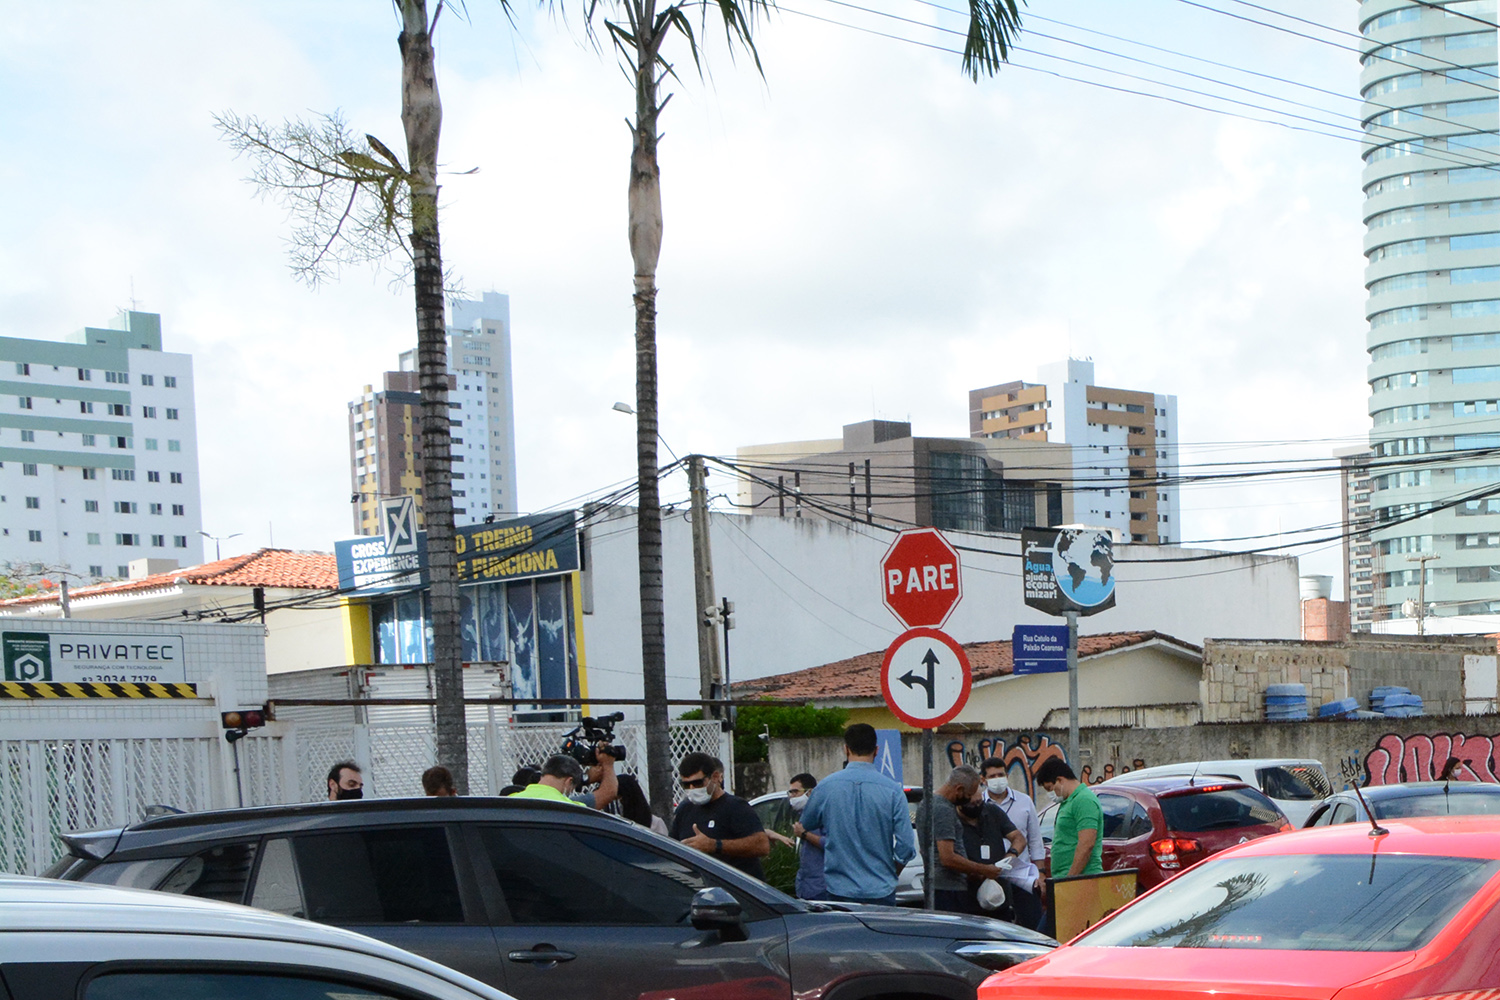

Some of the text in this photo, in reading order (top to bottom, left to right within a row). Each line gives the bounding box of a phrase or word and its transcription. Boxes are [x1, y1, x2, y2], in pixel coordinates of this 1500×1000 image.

[471, 525, 532, 551] TREINO
[351, 541, 385, 559] CROSS
[352, 554, 419, 575] EXPERIENCE
[472, 549, 558, 579] FUNCIONA
[1025, 558, 1053, 573] Água,
[888, 563, 954, 595] PARE
[1025, 572, 1048, 583] ajude
[1025, 582, 1057, 591] econo-
[1025, 590, 1057, 599] mizar!
[1022, 634, 1033, 642] Rua
[1034, 634, 1050, 642] Catulo
[59, 643, 174, 660] PRIVATEC
